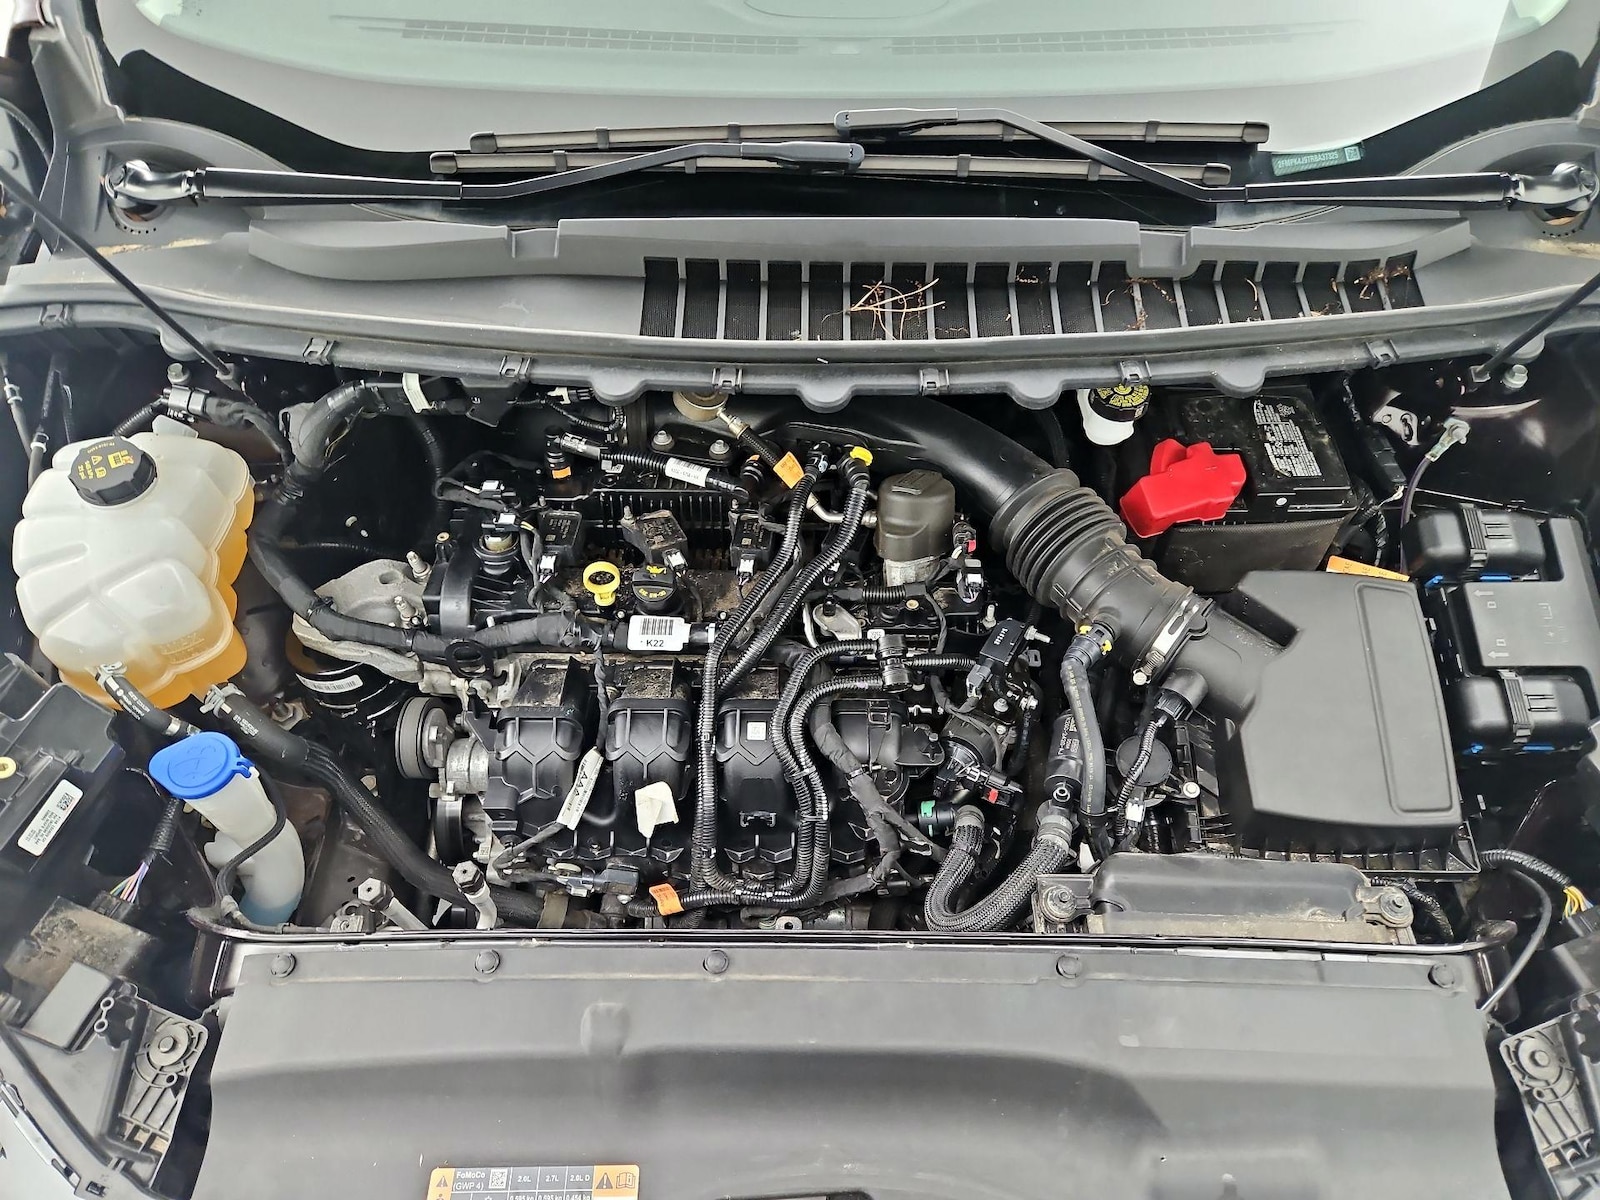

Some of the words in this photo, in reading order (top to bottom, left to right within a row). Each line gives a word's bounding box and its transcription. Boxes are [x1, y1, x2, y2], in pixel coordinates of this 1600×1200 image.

[646, 639, 664, 648] K22
[456, 1171, 486, 1179] FoMoCo
[545, 1174, 559, 1182] 2.7L
[452, 1182, 475, 1191] (GWP
